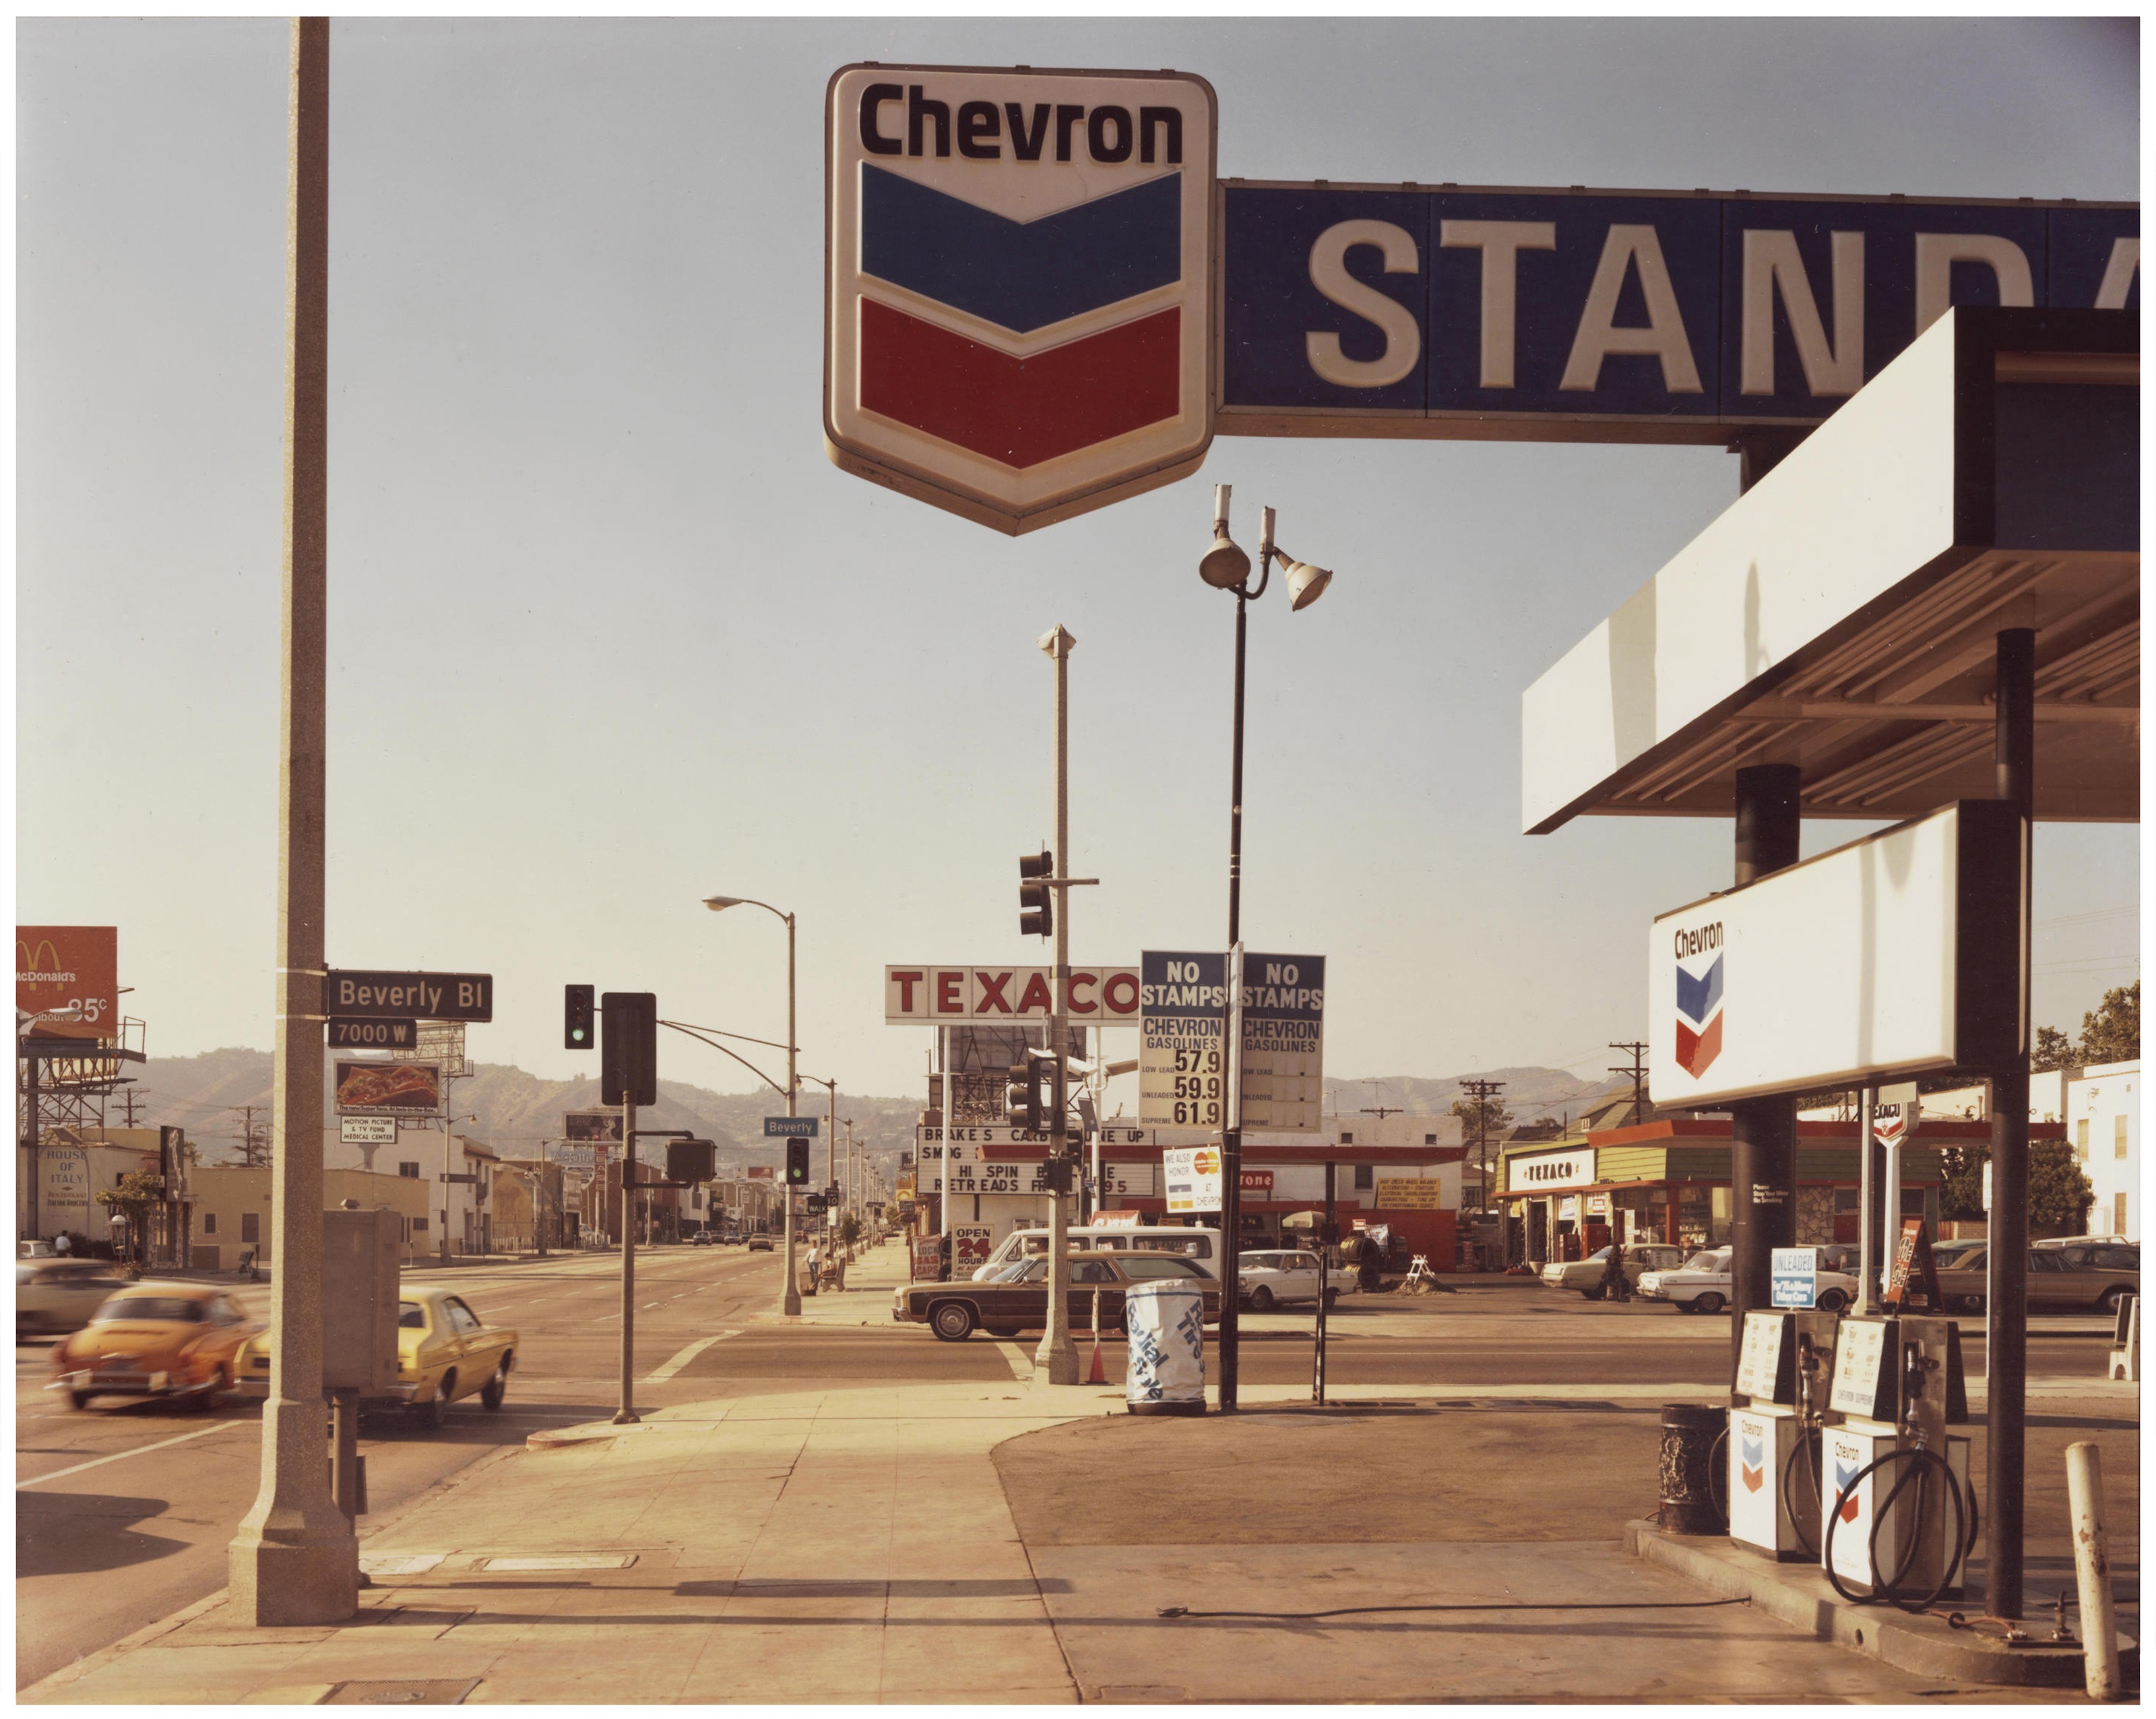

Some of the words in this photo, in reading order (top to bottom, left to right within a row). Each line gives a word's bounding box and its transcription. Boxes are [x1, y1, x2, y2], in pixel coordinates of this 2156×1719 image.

[859, 83, 1183, 164] Chevron
[1305, 218, 2140, 397] STAND
[1674, 921, 1723, 960] Chevron
[1167, 961, 1200, 983] NO
[1266, 963, 1299, 985] NO
[340, 980, 442, 1013] Beverly
[459, 982, 482, 1008] Bl
[891, 971, 1139, 1014] TEXACO
[1142, 984, 1225, 1007] STAMPS
[1242, 986, 1323, 1010] STAMPS
[338, 1024, 387, 1042] 7000
[393, 1025, 407, 1042] W
[1143, 1018, 1222, 1036] CHEVRON
[1242, 1020, 1320, 1039] CHEVRON
[1147, 1036, 1217, 1050] GASOLINES
[1245, 1038, 1316, 1053] GASOLINES
[1175, 1049, 1220, 1073] 57.9
[1174, 1076, 1220, 1099] 59.9
[1174, 1101, 1219, 1125] 61.9
[769, 1121, 813, 1135] Beverly
[925, 1129, 992, 1141] BRAKES
[1127, 1131, 1144, 1142] UP
[922, 1147, 961, 1159] SMG
[1165, 1154, 1174, 1164] WE
[1176, 1153, 1191, 1163] ALSO
[60, 1162, 75, 1171] OF
[959, 1166, 972, 1178] HI
[986, 1166, 1018, 1178] SPIN
[1169, 1166, 1189, 1177] HONOR
[1529, 1161, 1573, 1181] TEXACO
[51, 1174, 84, 1183] ITALY
[934, 1179, 1019, 1191] RETREADS
[957, 1228, 990, 1238] OPEN
[918, 1245, 938, 1255] LOCK
[957, 1238, 991, 1257] 24
[917, 1256, 939, 1265] GAS
[1773, 1255, 1813, 1272] UNLEADED
[917, 1266, 938, 1276] CAPS
[1177, 1311, 1201, 1360] Tire
[1742, 1418, 1764, 1437] Chevron
[1835, 1441, 1860, 1462] Chevron
